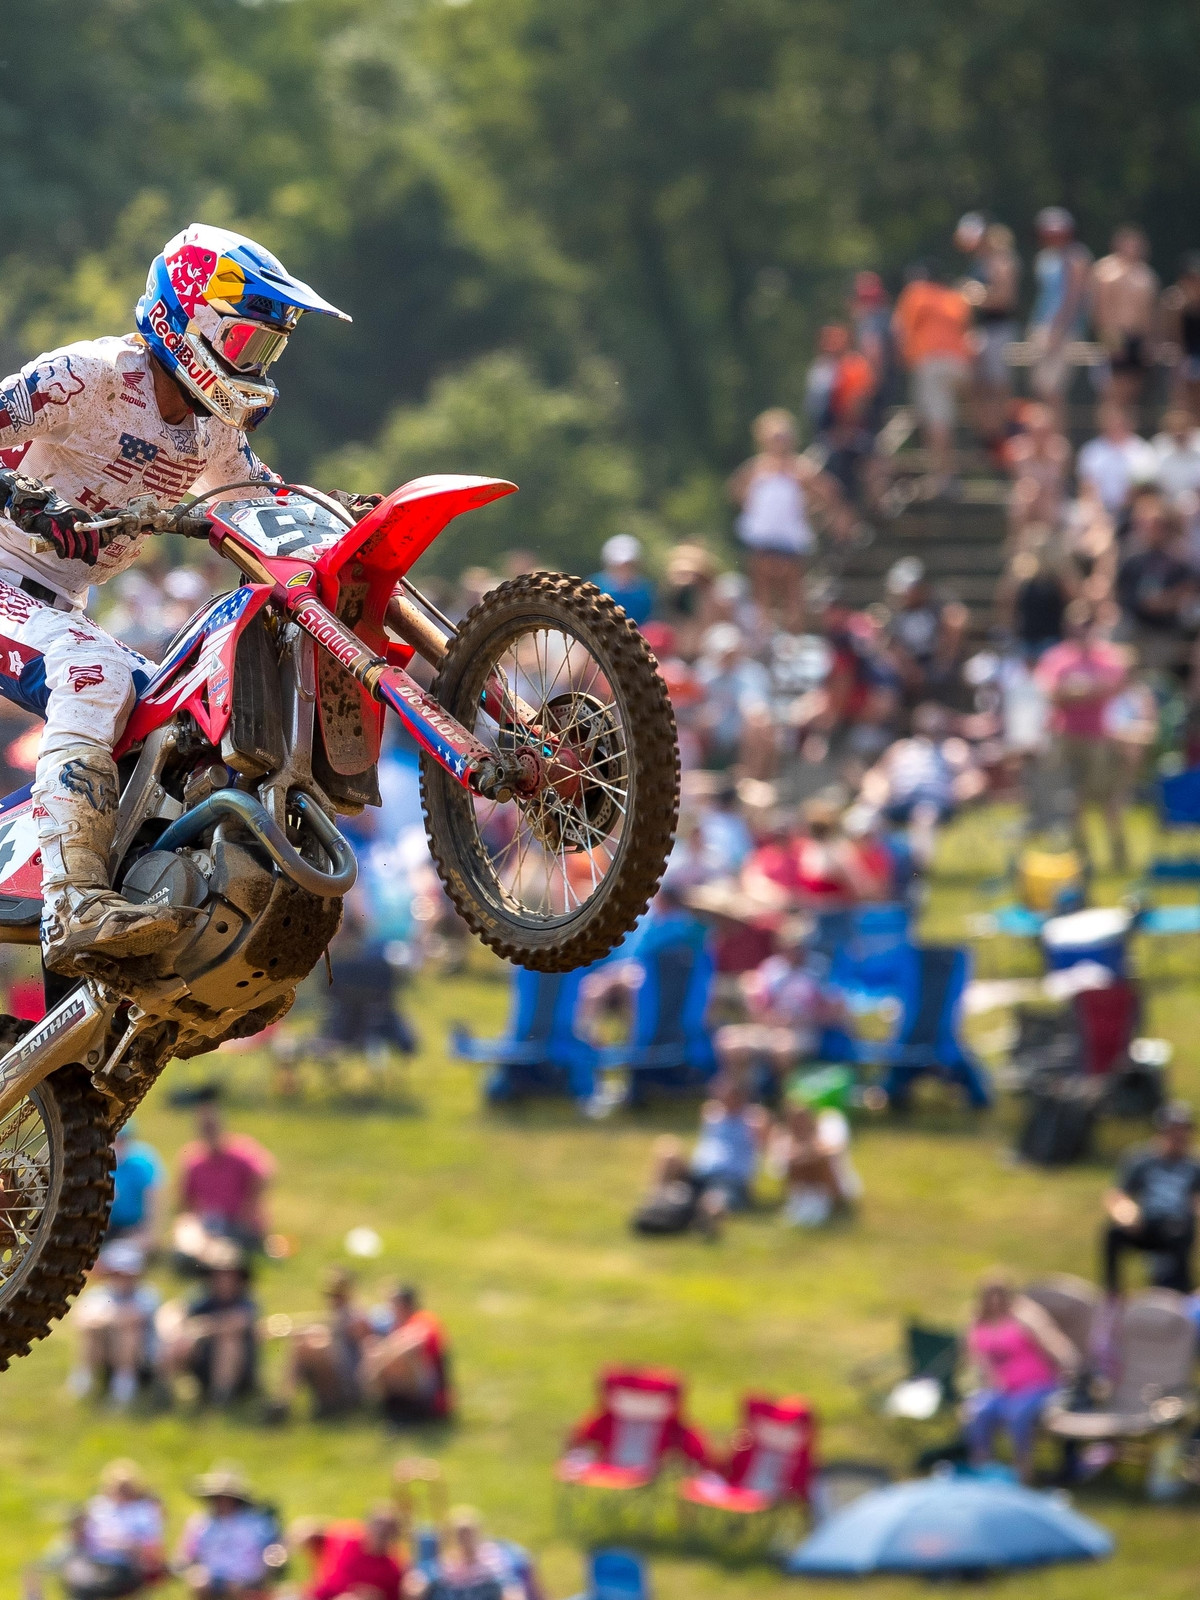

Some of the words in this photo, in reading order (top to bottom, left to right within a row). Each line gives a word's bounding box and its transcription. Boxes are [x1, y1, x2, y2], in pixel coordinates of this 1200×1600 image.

[148, 300, 184, 352] Red
[175, 343, 219, 392] Bull
[119, 392, 147, 410] SHOWA
[297, 608, 362, 668] SHOWA
[395, 685, 466, 745] DUNLOP
[141, 886, 170, 905] ONDA
